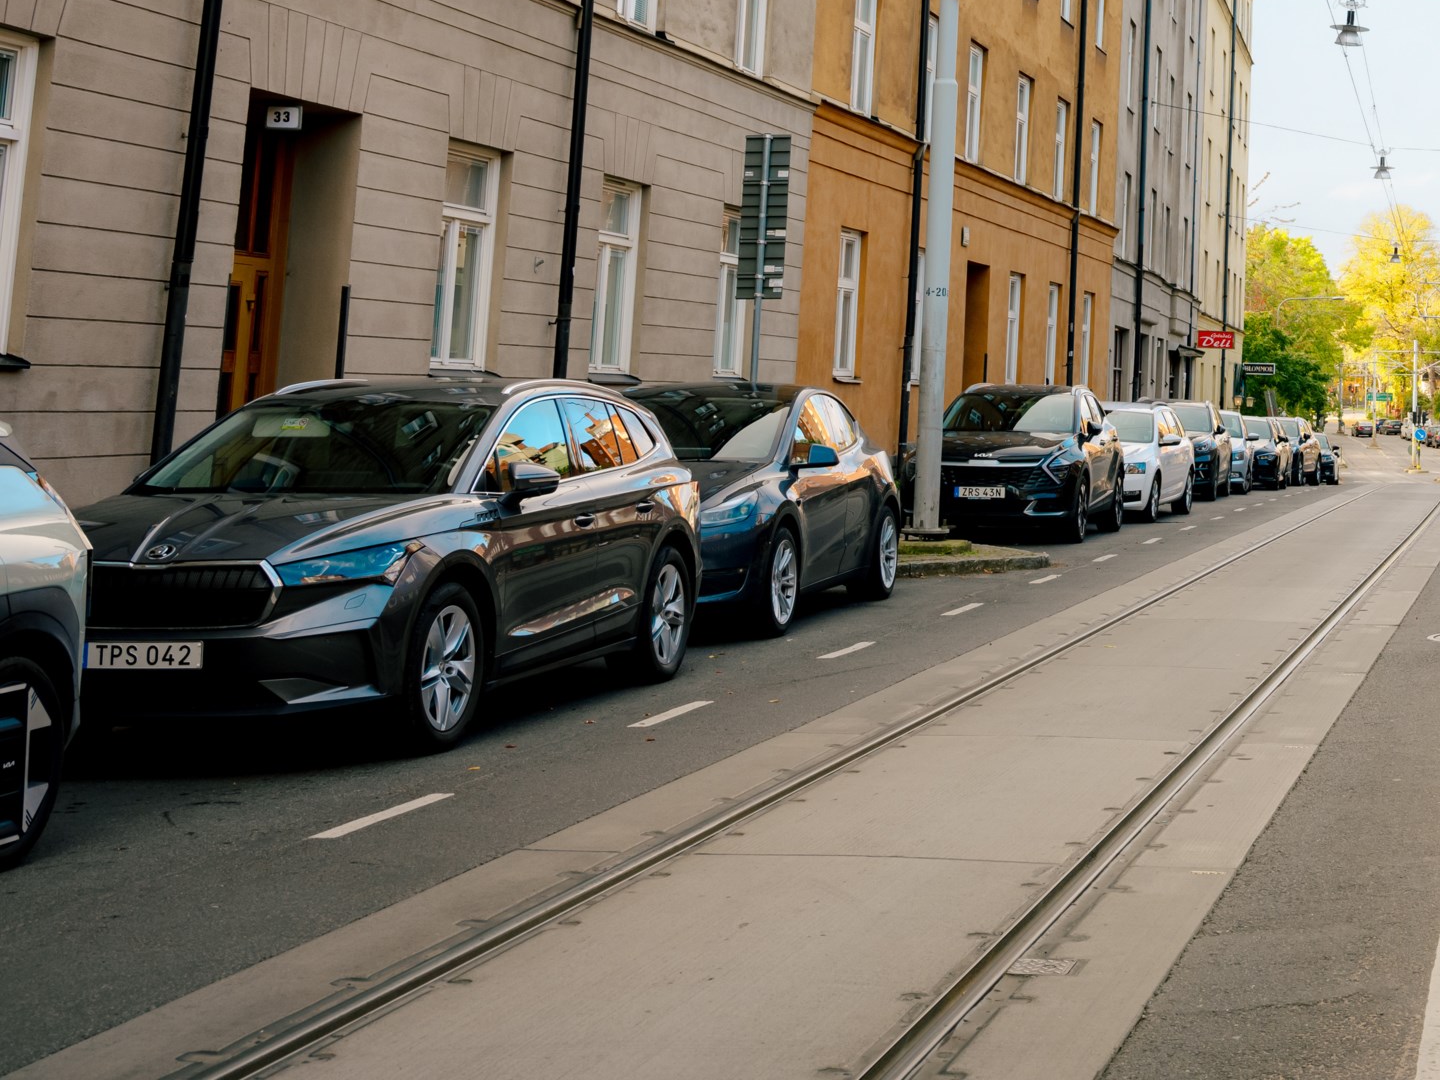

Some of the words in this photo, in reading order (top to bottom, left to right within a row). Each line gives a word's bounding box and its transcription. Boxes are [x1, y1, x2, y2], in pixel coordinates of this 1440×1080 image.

[273, 111, 290, 123] 33
[1200, 336, 1231, 348] Deli
[962, 487, 980, 497] ZRS
[982, 487, 1001, 497] 43N
[96, 645, 138, 666] TPS
[146, 645, 191, 666] 042
